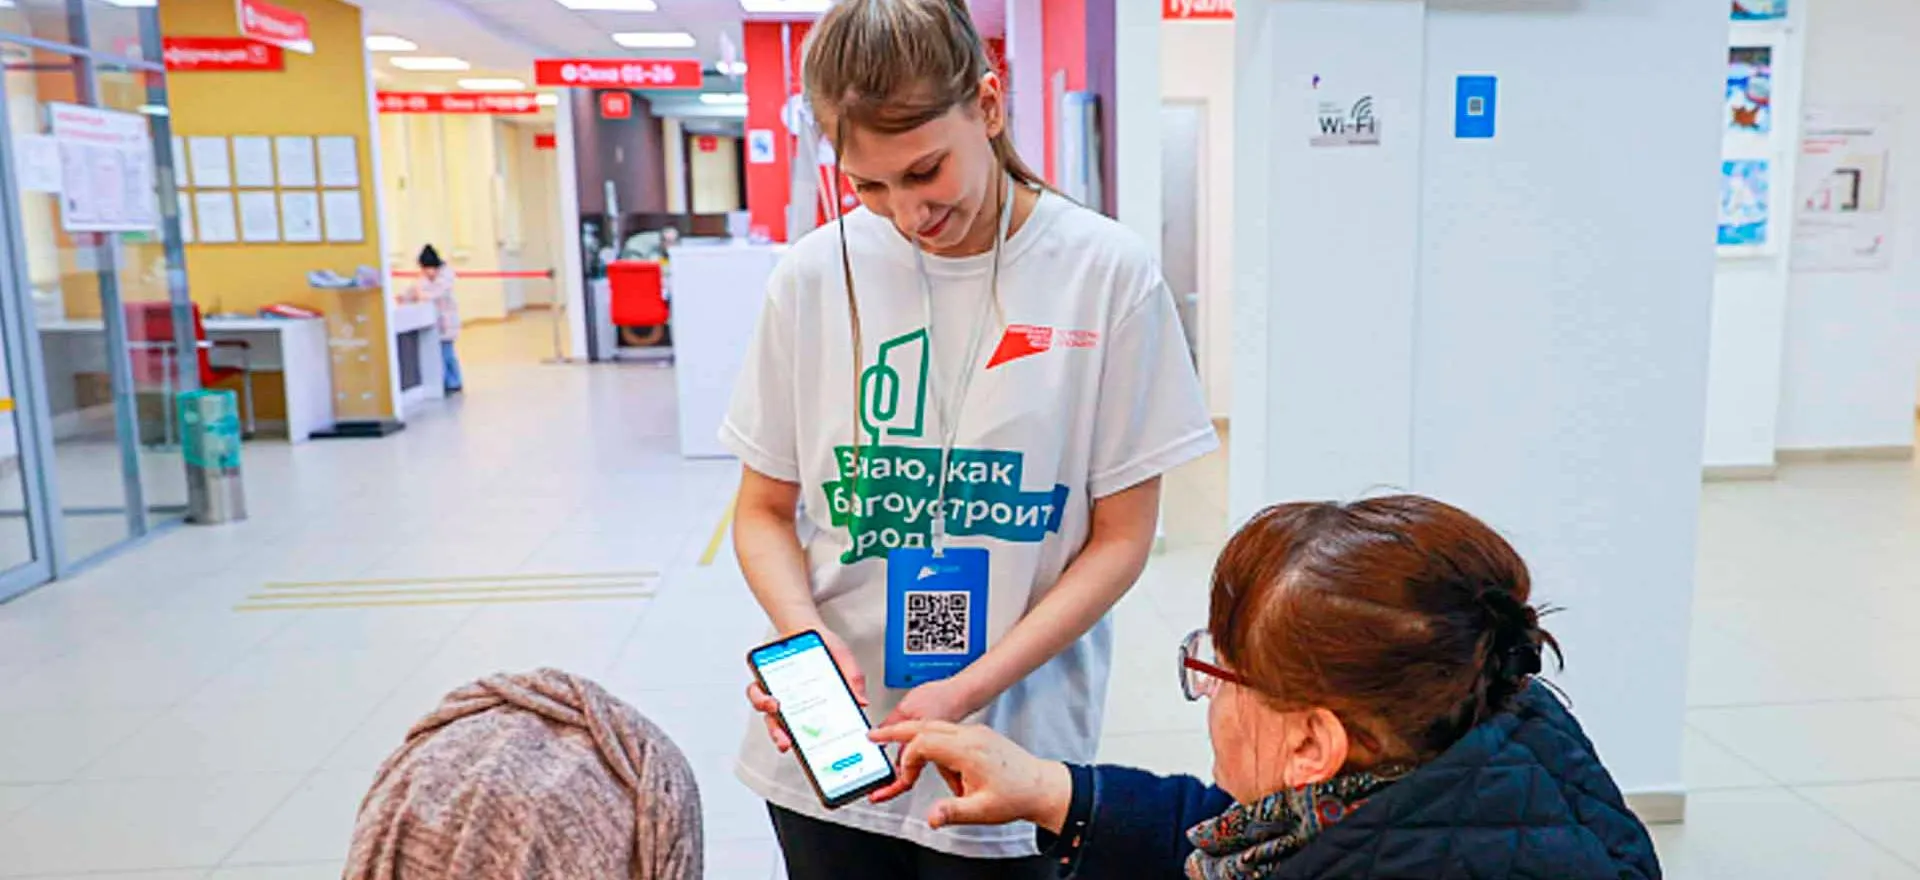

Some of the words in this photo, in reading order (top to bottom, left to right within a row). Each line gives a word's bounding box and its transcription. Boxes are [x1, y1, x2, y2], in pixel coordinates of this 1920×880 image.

[1319, 116, 1375, 134] Wi-Fi
[947, 461, 1014, 486] как
[856, 527, 926, 556] род
